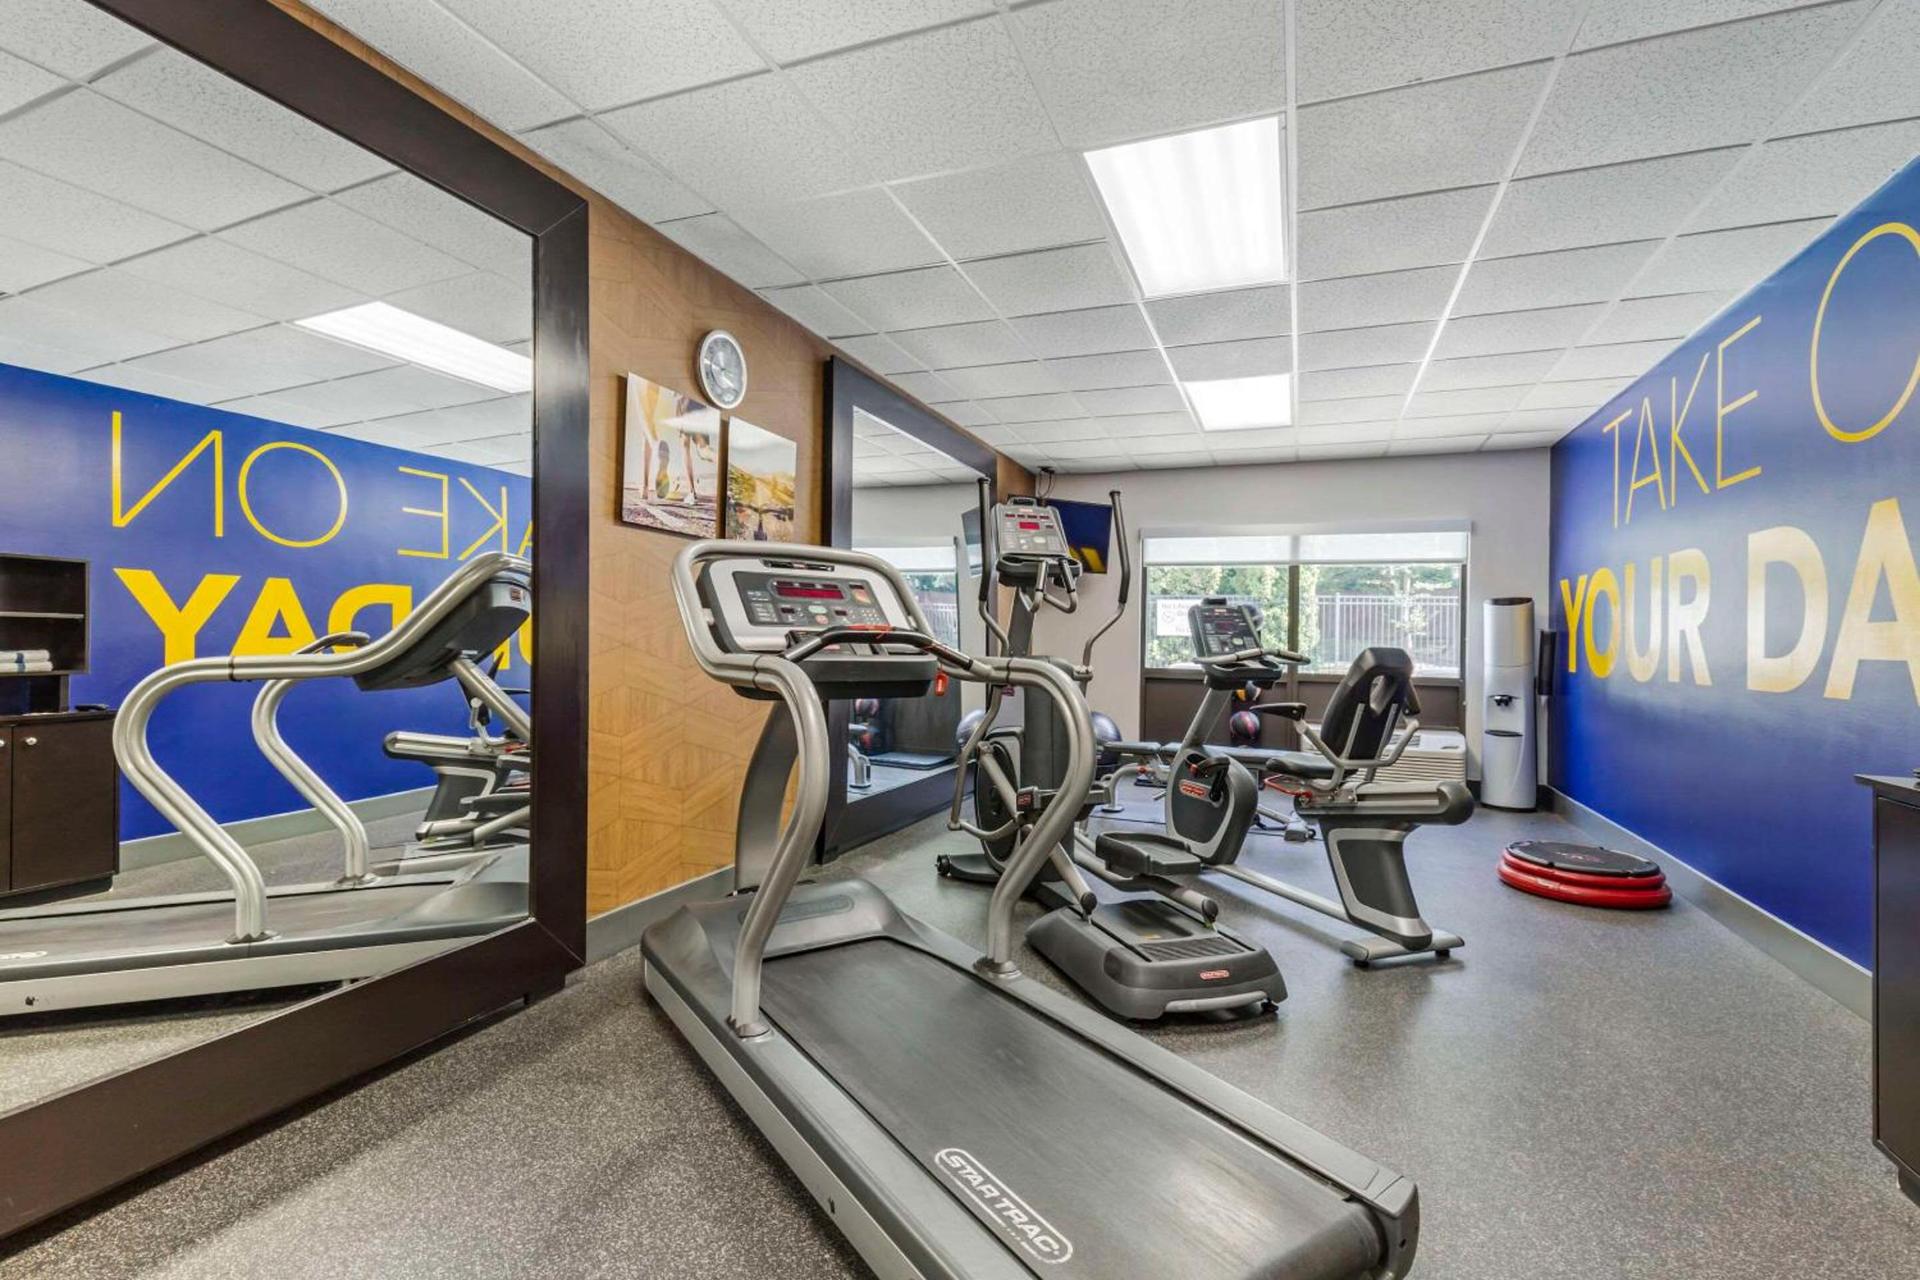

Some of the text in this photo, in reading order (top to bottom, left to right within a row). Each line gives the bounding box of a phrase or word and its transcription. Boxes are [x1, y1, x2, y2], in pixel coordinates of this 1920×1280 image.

[1603, 315, 1762, 528] TAKE
[1560, 497, 1920, 707] YOUR DA
[940, 1152, 1061, 1254] STAR TRAC
